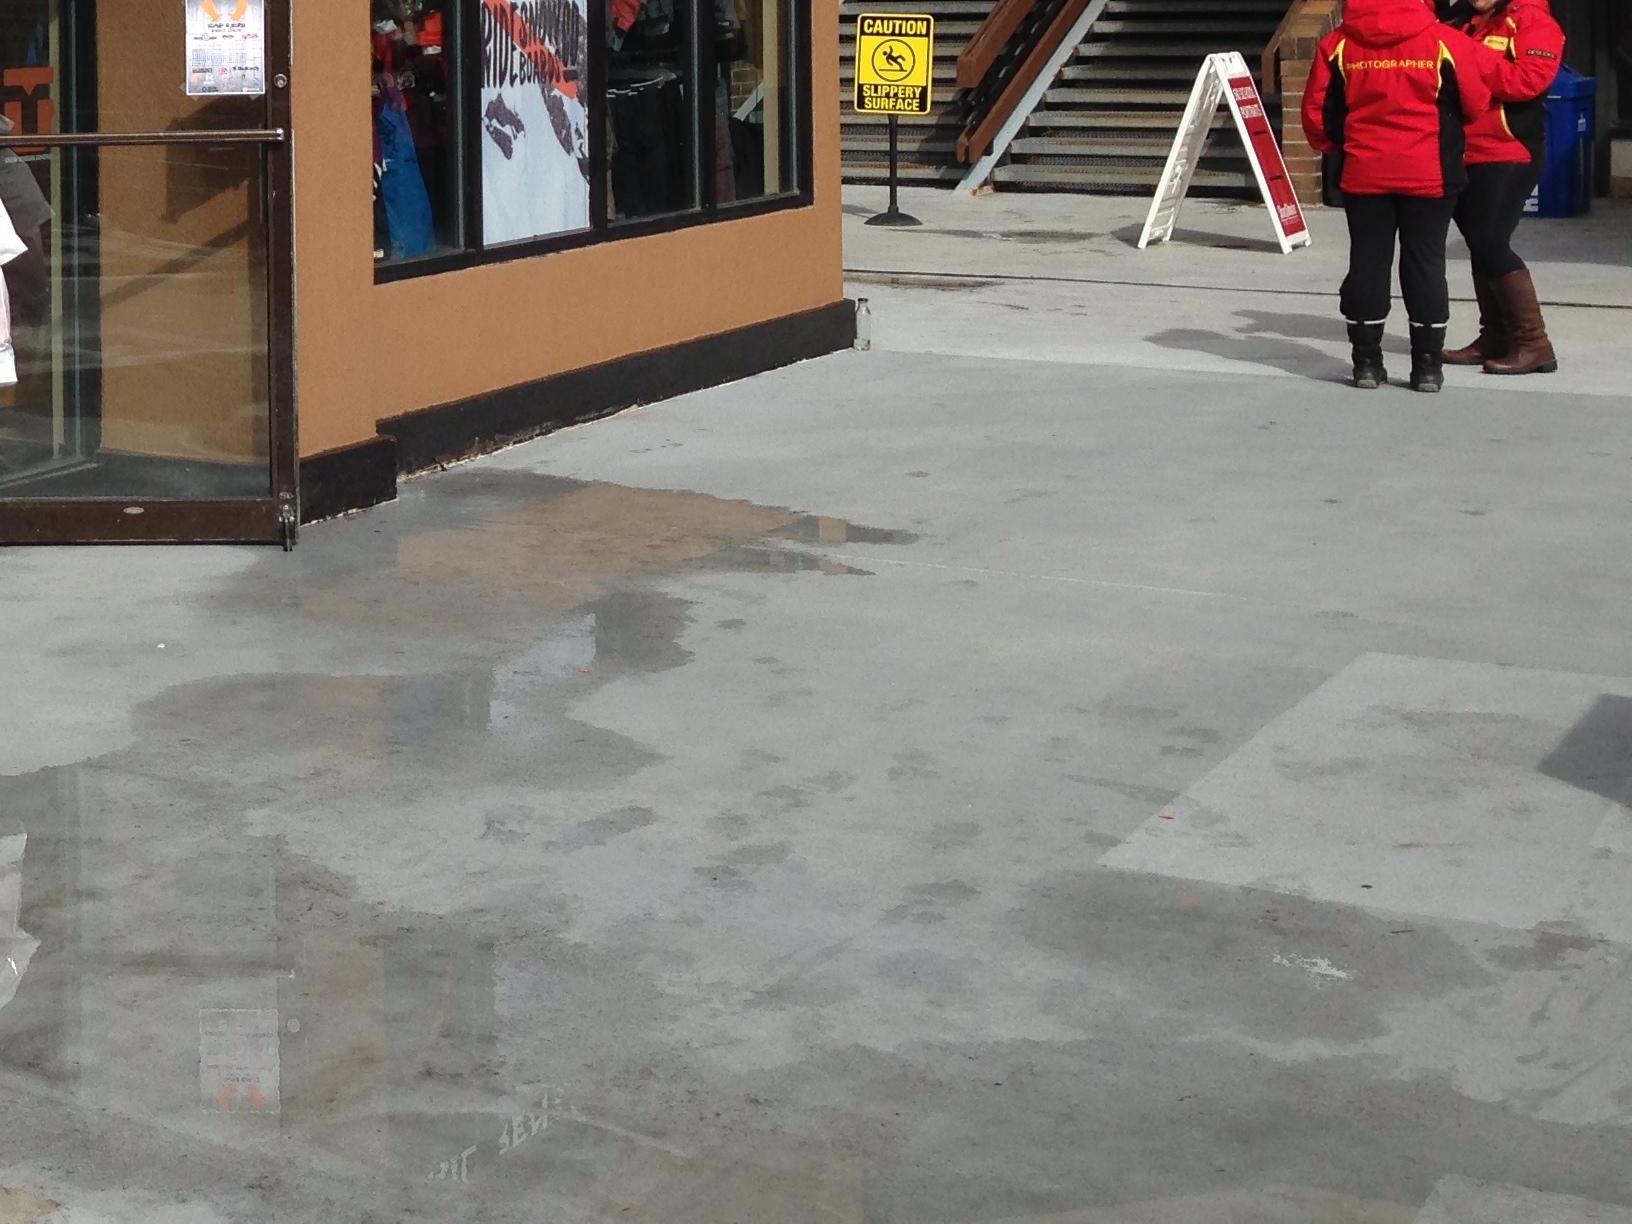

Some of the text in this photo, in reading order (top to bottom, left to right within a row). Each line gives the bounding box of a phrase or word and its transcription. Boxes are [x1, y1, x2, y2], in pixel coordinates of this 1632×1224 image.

[863, 19, 927, 35] CAUTION
[481, 1, 519, 89] RIDE
[1346, 59, 1434, 70] PHOTOGRAPHER
[862, 84, 922, 98] SLIPPERY
[864, 97, 920, 111] SURFACE
